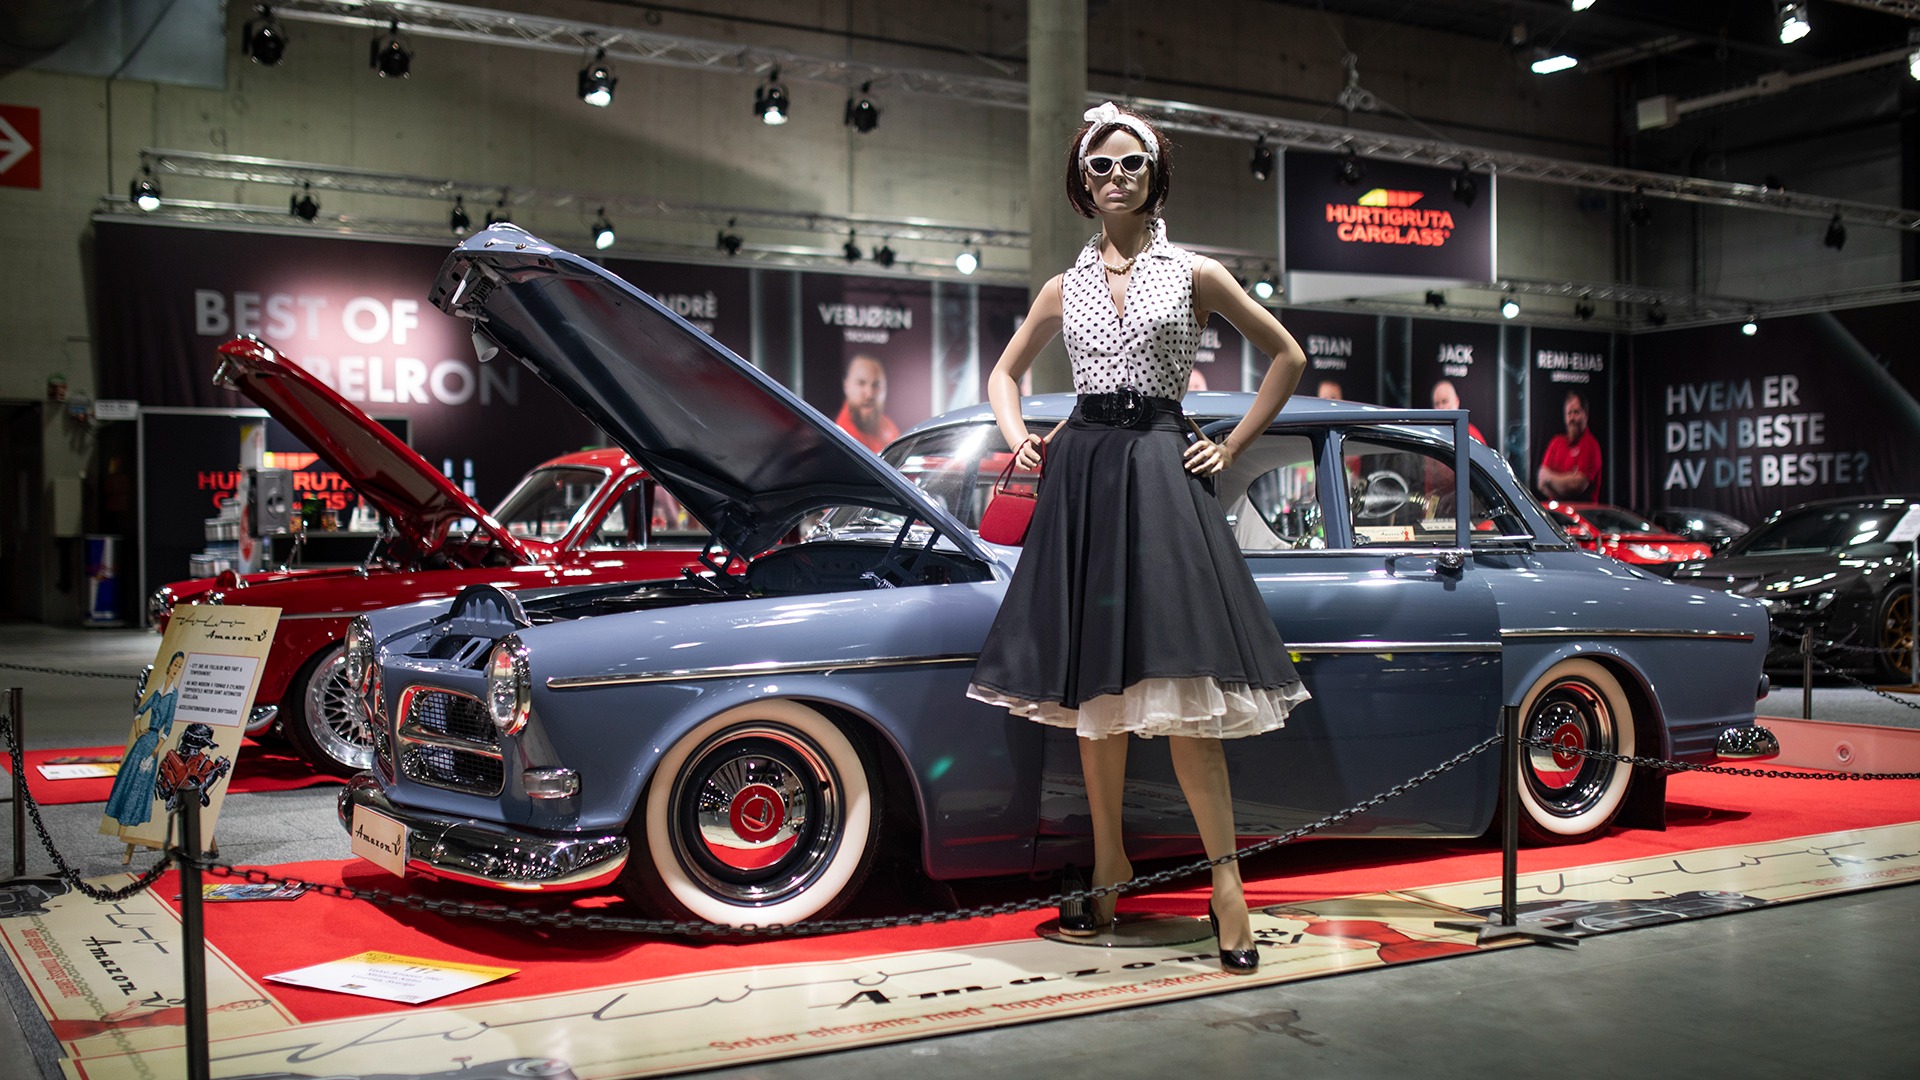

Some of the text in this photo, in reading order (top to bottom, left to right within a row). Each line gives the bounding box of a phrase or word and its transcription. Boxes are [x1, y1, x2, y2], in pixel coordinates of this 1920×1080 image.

[1326, 203, 1455, 229] HURTIGRUTA
[195, 289, 419, 346] BEST OF
[818, 303, 912, 329] VEBJØRN
[1307, 335, 1353, 358] STIAN
[1437, 343, 1474, 365] JACK
[1536, 350, 1604, 372] REMI-ELIAS
[303, 356, 518, 405] BELRON
[1666, 374, 1800, 415] HVEM ER
[1666, 412, 1825, 453] DEN BESTE
[1664, 452, 1869, 490] AV DE BESTE?
[205, 630, 253, 642] Amazon
[355, 824, 392, 853] Amazon
[82, 936, 138, 996] Amazon
[808, 954, 1221, 1010] Amazon
[709, 1032, 799, 1053] Sober
[806, 1016, 918, 1040] elegans
[925, 1006, 983, 1026] med
[991, 982, 1141, 1012] toppklassig
